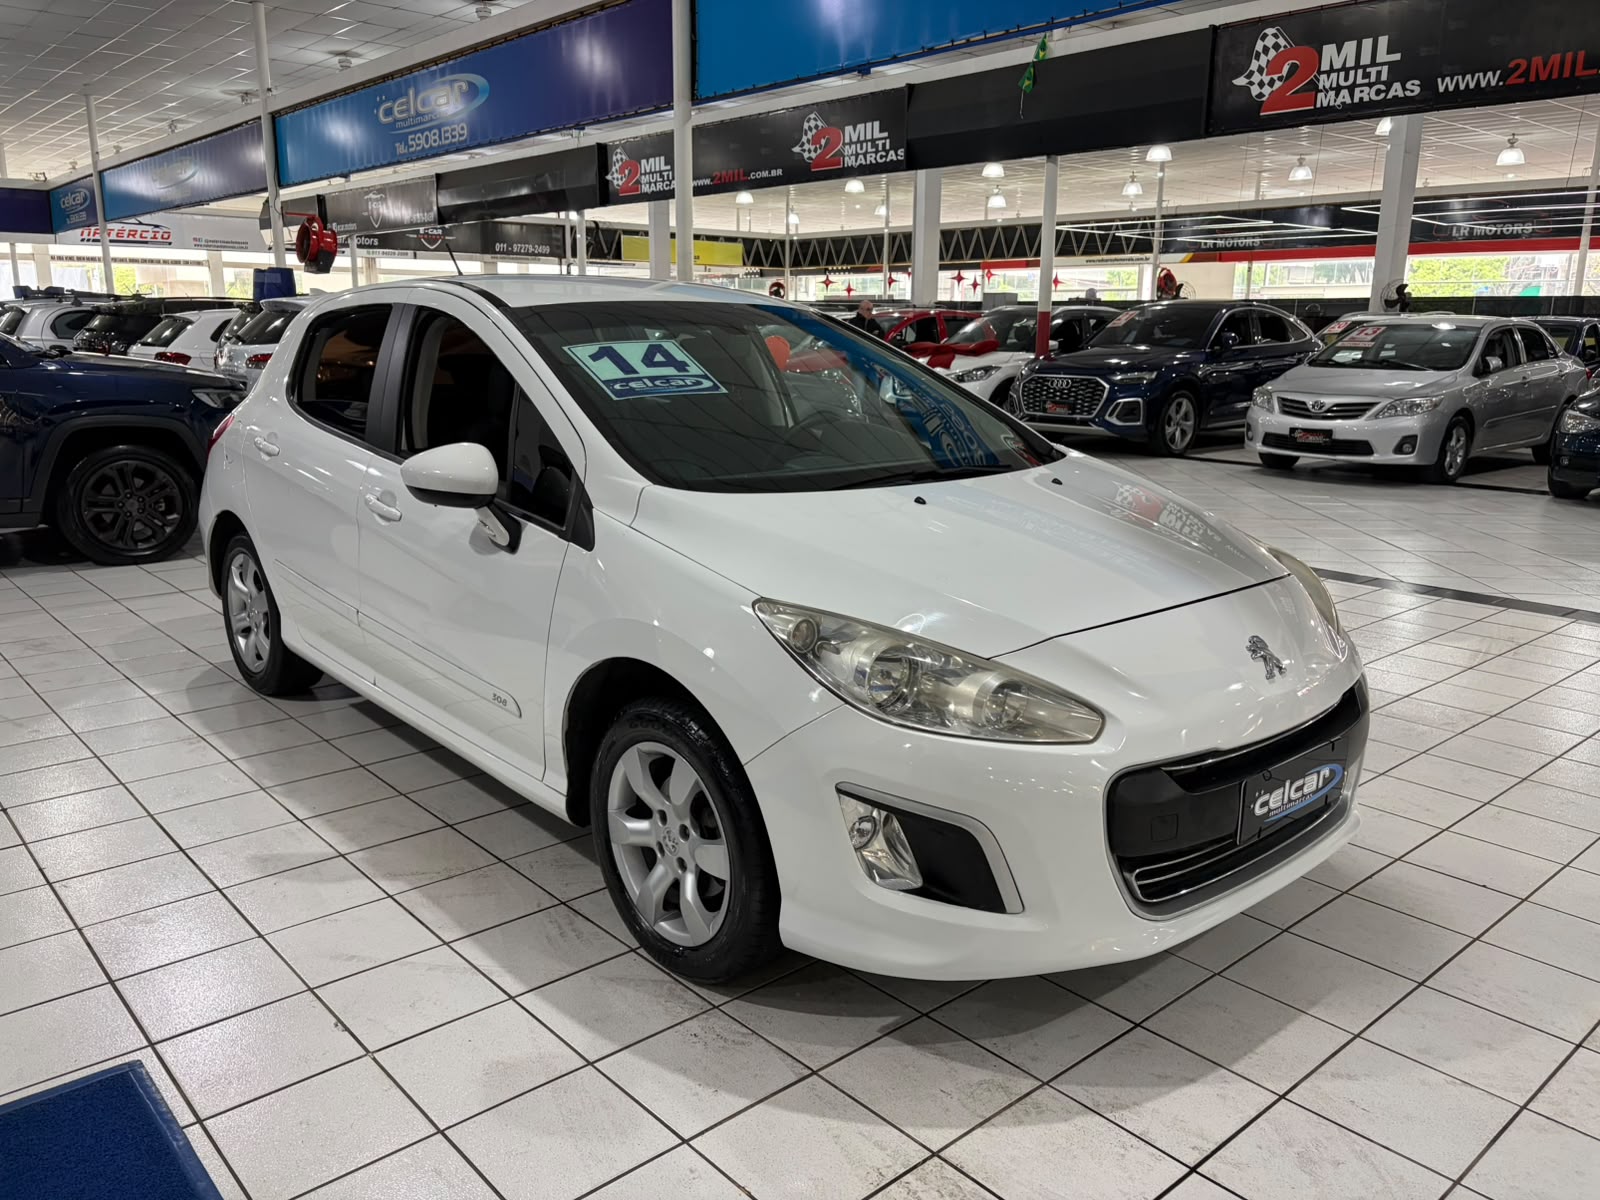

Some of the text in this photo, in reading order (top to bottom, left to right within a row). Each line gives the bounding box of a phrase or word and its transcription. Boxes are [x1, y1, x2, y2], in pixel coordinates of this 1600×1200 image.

[1260, 35, 1402, 116] 2 MIL
[1318, 65, 1389, 90] MULTI
[377, 79, 469, 125] celcar
[1316, 79, 1421, 109] MARCAS
[408, 122, 468, 153] 5908.1339
[811, 120, 889, 171] 2 MIL
[843, 138, 890, 156] MULTI
[843, 148, 905, 168] MARCAS
[618, 156, 671, 196] 2 MIL
[641, 171, 673, 183] MULTI
[641, 180, 676, 194] MARCA
[1473, 222, 1533, 237] MOTORS
[588, 344, 691, 376] 14
[613, 378, 697, 390] celcar
[1254, 766, 1330, 817] celcar
